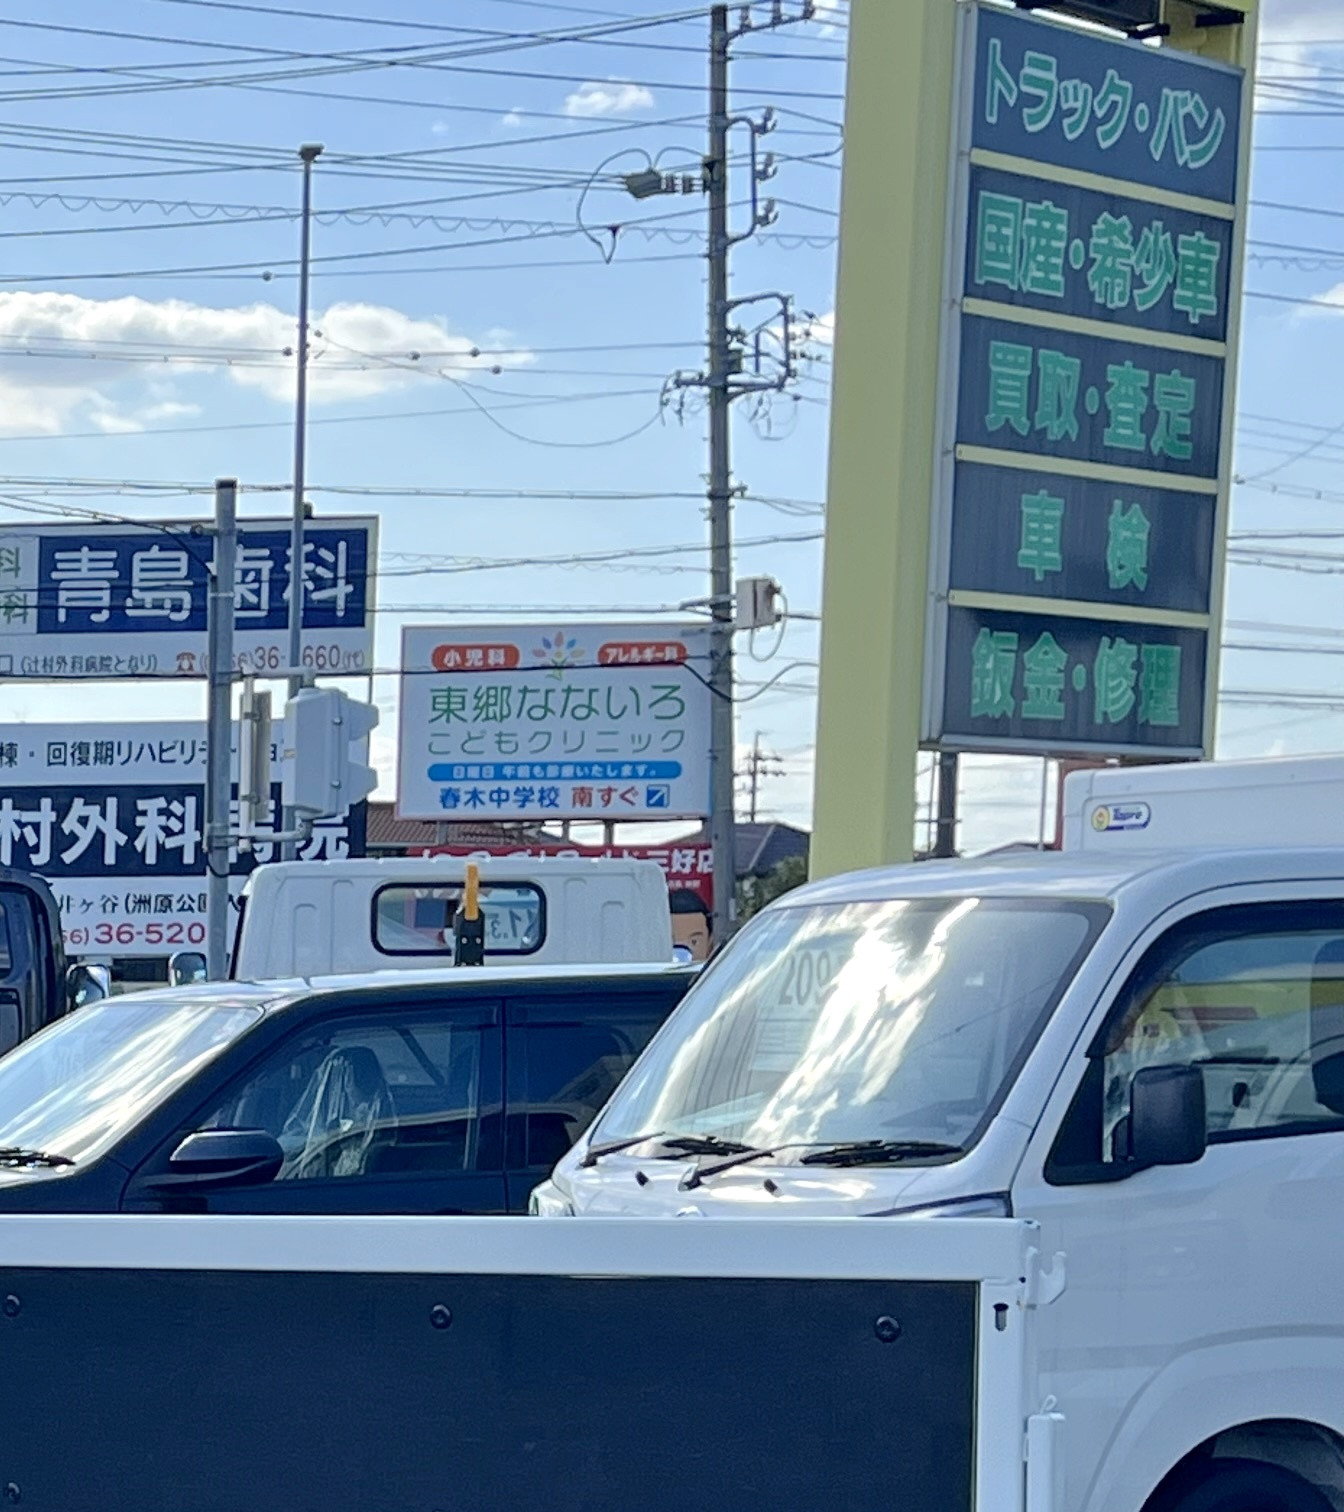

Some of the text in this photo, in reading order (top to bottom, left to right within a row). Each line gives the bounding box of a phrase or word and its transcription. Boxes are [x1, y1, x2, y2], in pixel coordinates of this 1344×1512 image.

[986, 38, 1226, 169] トラック・バン
[975, 190, 1220, 323] 国産・希少車
[986, 341, 1195, 460] 買取・査定
[51, 541, 354, 622] 青島歯科
[428, 685, 686, 724] 東郷なないろ
[971, 627, 1182, 726] 鈑金・修理
[428, 730, 685, 756] こどもクリニック
